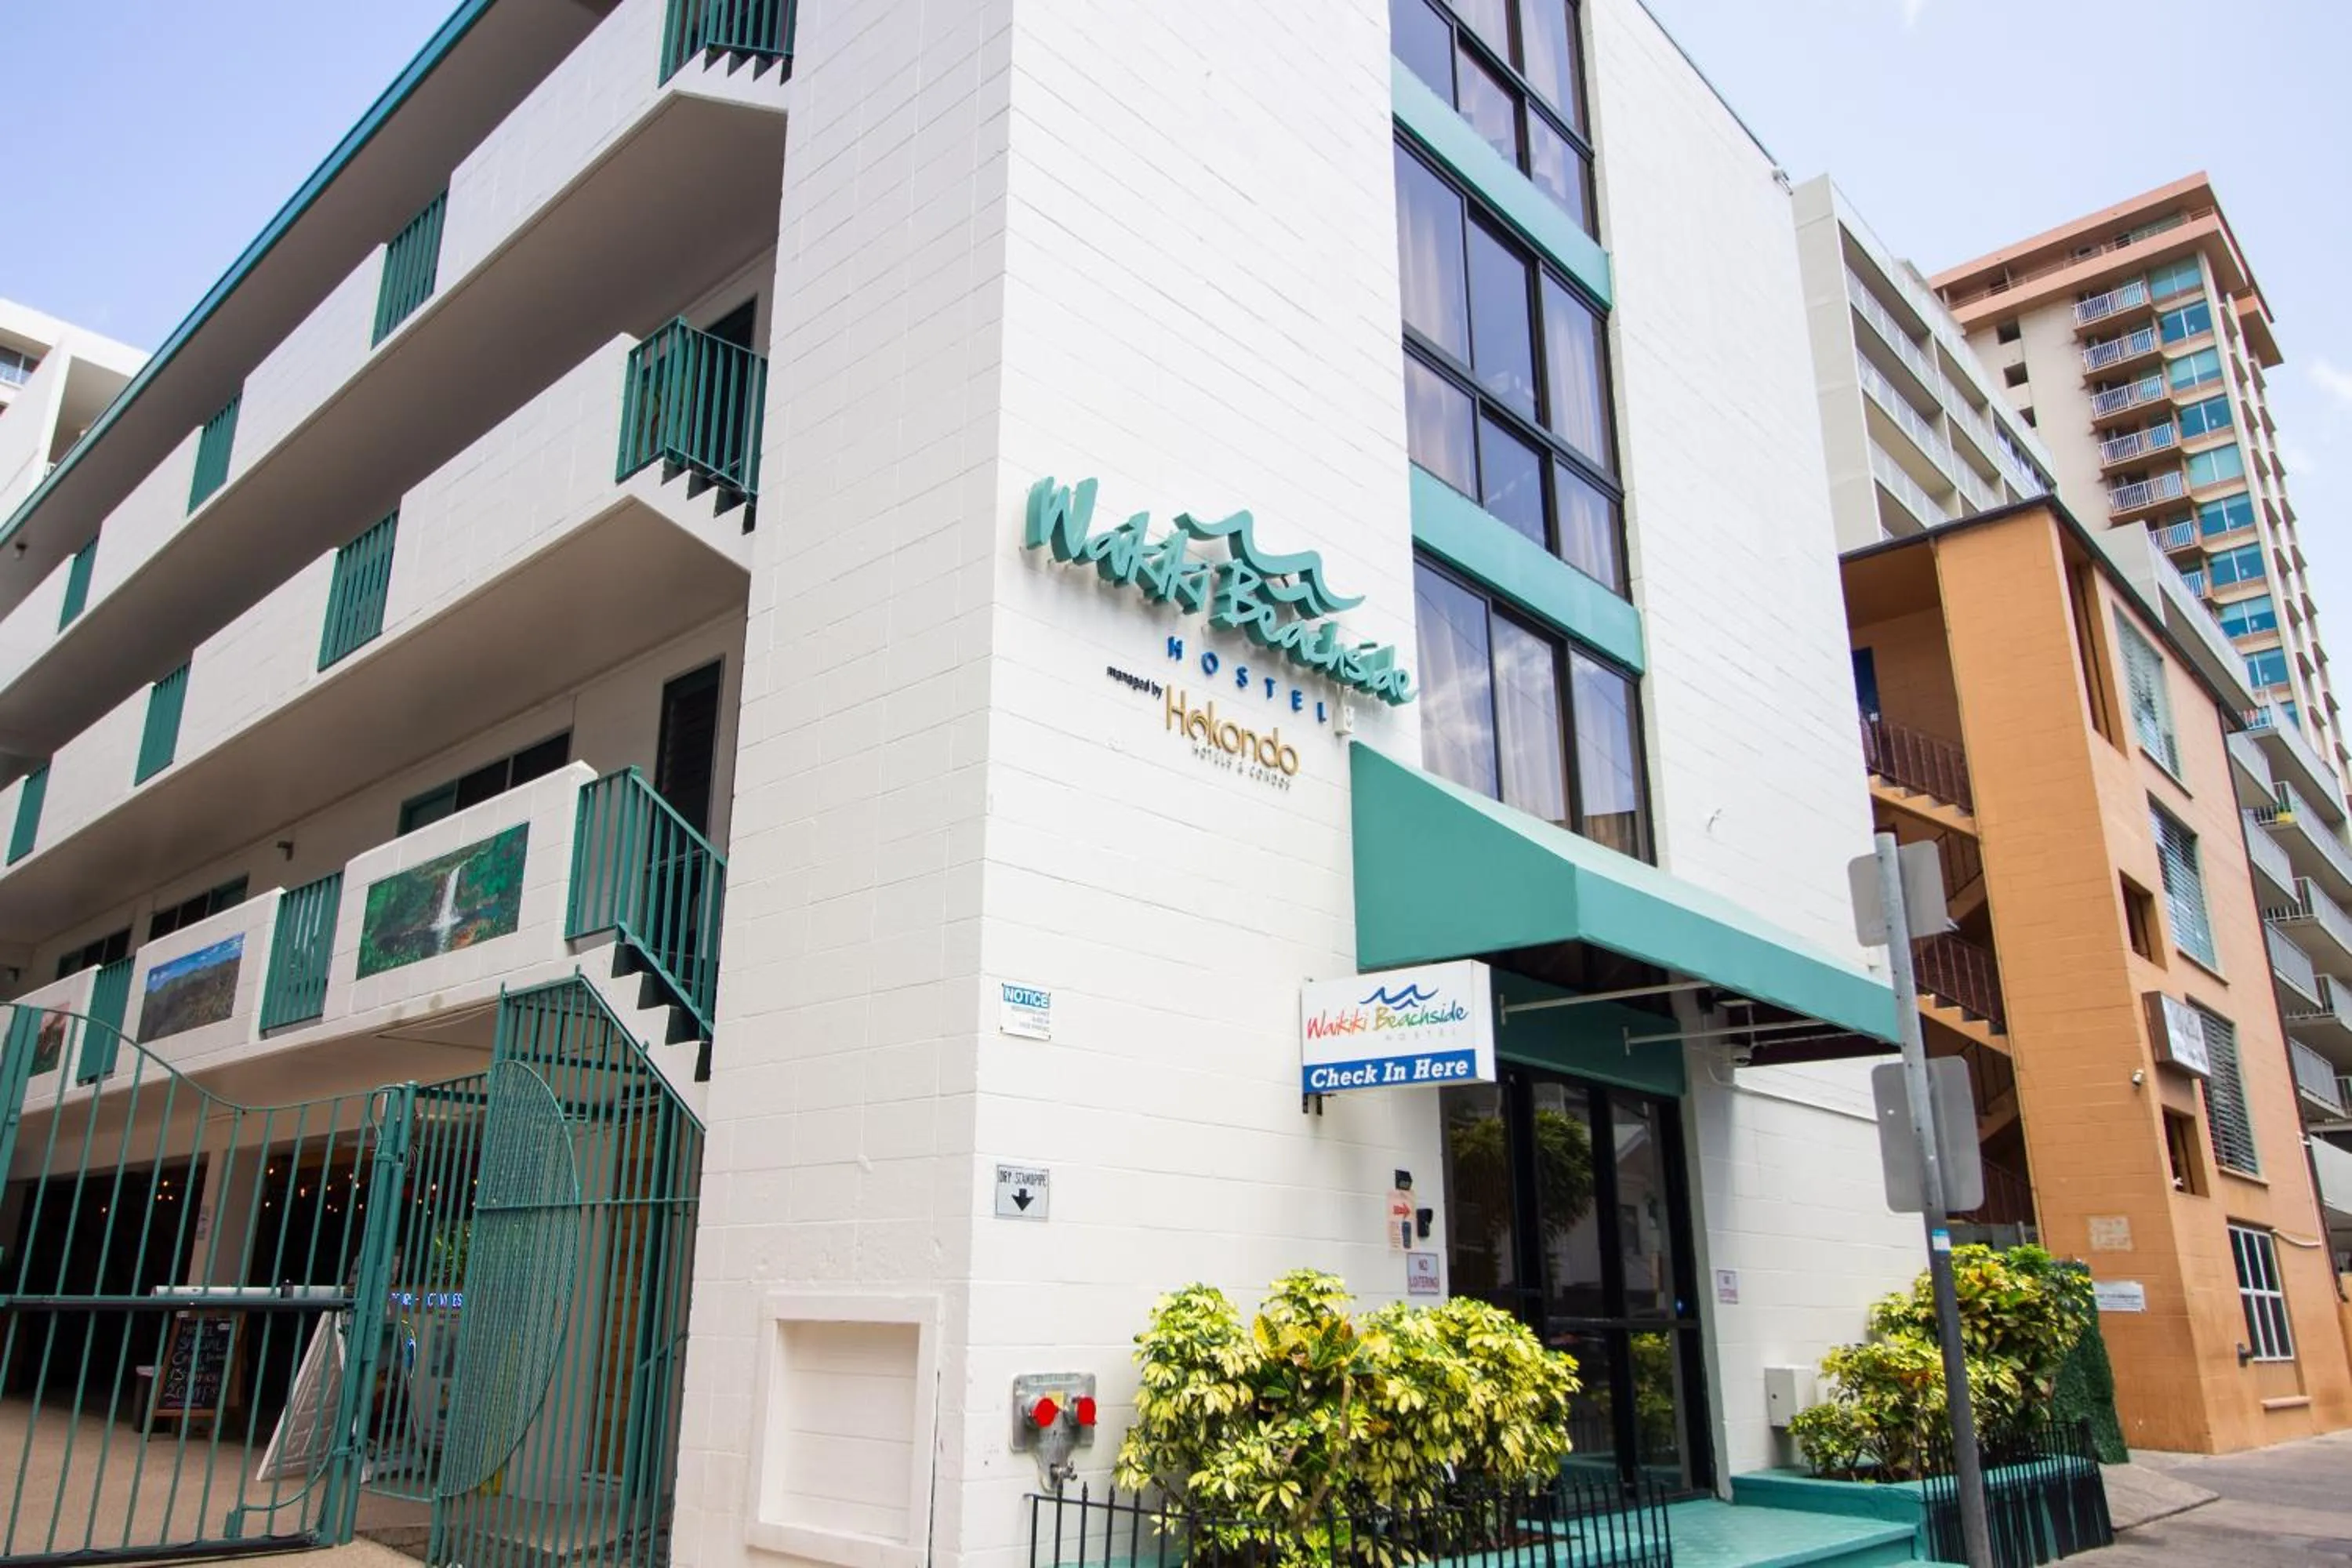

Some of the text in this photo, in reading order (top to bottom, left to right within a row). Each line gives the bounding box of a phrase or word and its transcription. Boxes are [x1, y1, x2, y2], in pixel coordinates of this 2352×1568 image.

[1025, 476, 1421, 707] Waikiki Beachside
[1106, 665, 1163, 700] managed by
[1167, 635, 1327, 723] HOSTEL
[1004, 987, 1048, 1007] NOTICE
[1307, 1000, 1469, 1040] Waikiki Beachside
[1310, 1058, 1468, 1088] Check In Here
